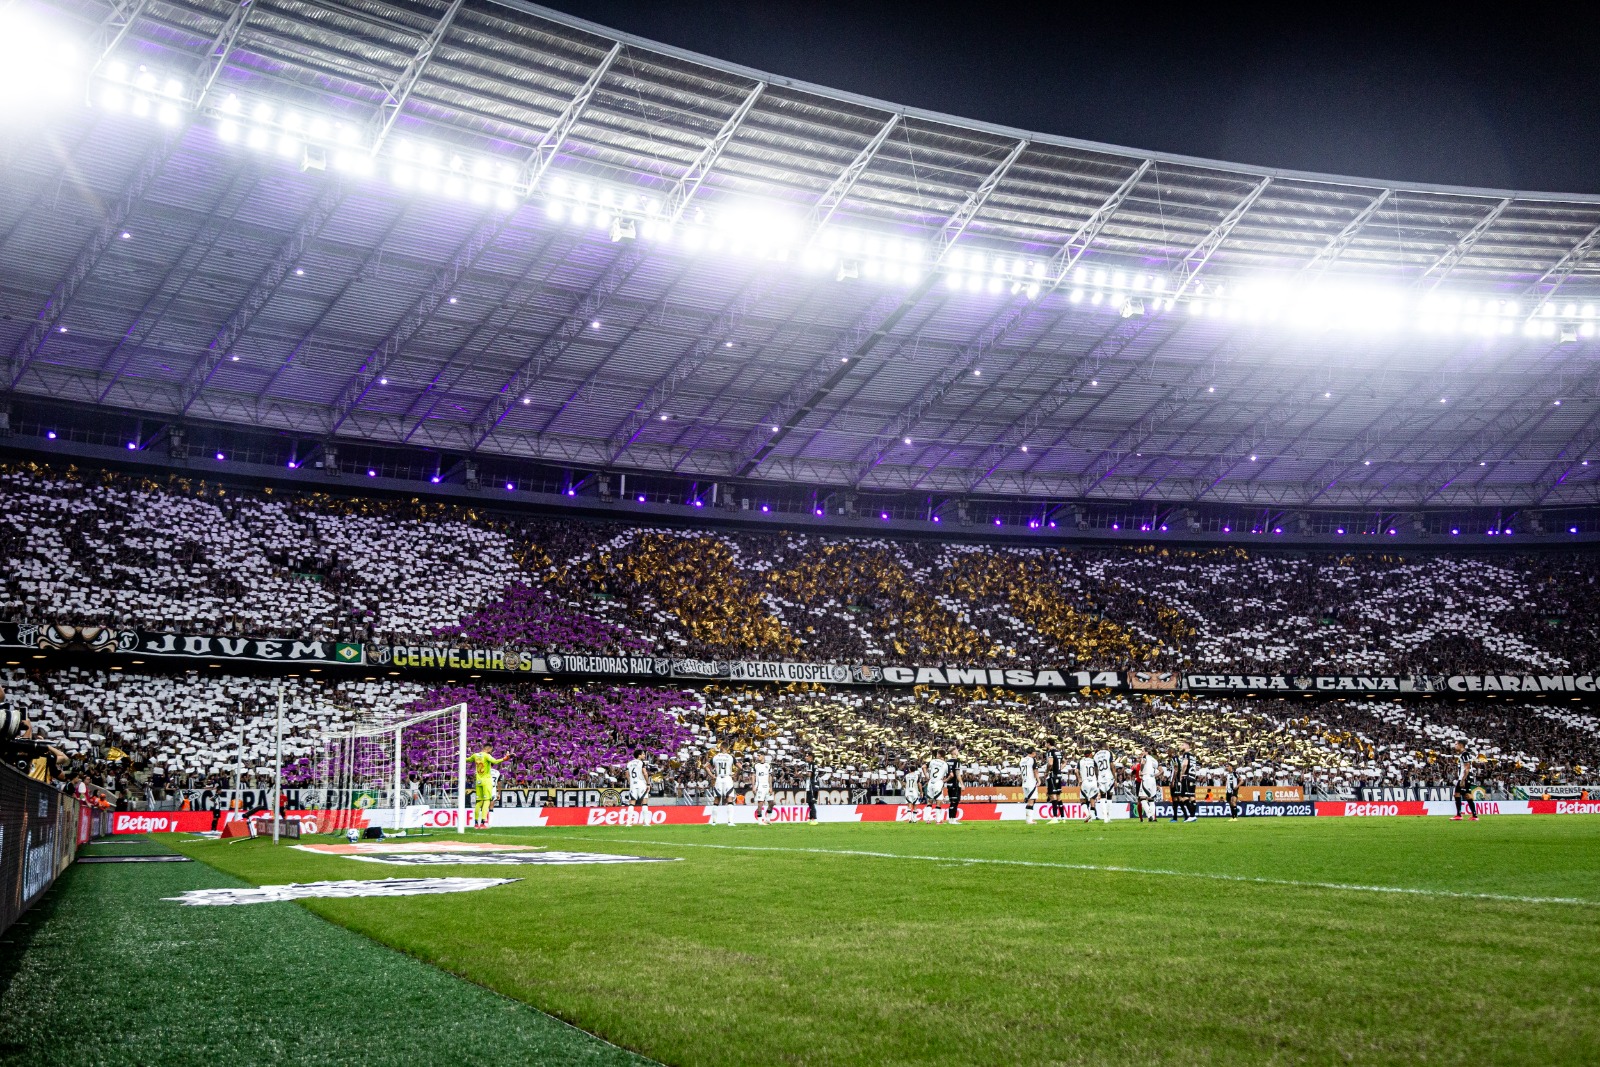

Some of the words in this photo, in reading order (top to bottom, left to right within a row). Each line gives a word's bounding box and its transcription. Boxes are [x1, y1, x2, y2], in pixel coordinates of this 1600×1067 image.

[146, 634, 326, 659] JOVEM
[563, 655, 629, 673] TORCEDORAS
[630, 657, 652, 674] RAIZ
[788, 664, 832, 680] GOSPEL
[882, 666, 1067, 687] CAMISA
[1069, 671, 1121, 687] 14
[1316, 676, 1399, 690] CANA
[718, 762, 726, 775] 14
[1085, 765, 1094, 777] 10
[1098, 760, 1108, 771] 20
[631, 767, 638, 779] 6
[932, 767, 940, 779] 2
[1274, 788, 1300, 798] CEARÁ
[1246, 803, 1285, 817] Betano
[1287, 804, 1312, 815] 2025
[1344, 802, 1399, 816] Betano
[117, 815, 168, 831] Betano
